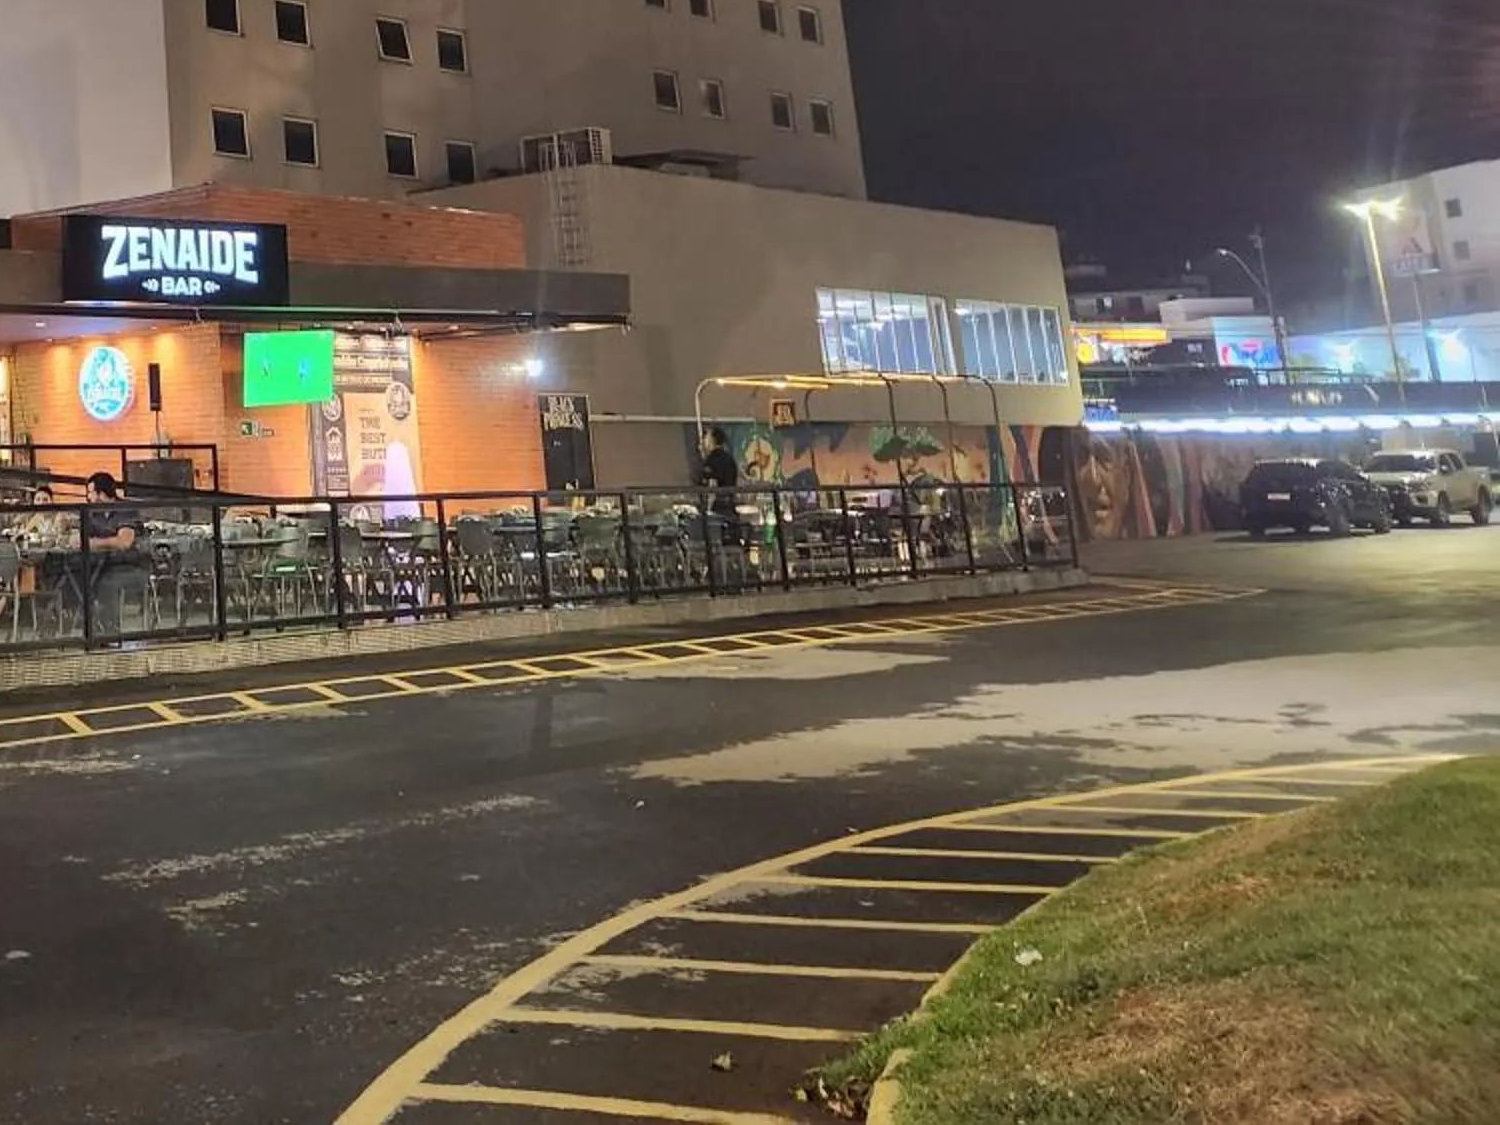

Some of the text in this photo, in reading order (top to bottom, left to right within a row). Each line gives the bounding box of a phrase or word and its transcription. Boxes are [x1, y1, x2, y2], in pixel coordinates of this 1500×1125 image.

[101, 225, 259, 284] ZENAIDE
[161, 277, 203, 296] BAR
[359, 432, 387, 444] BEST
